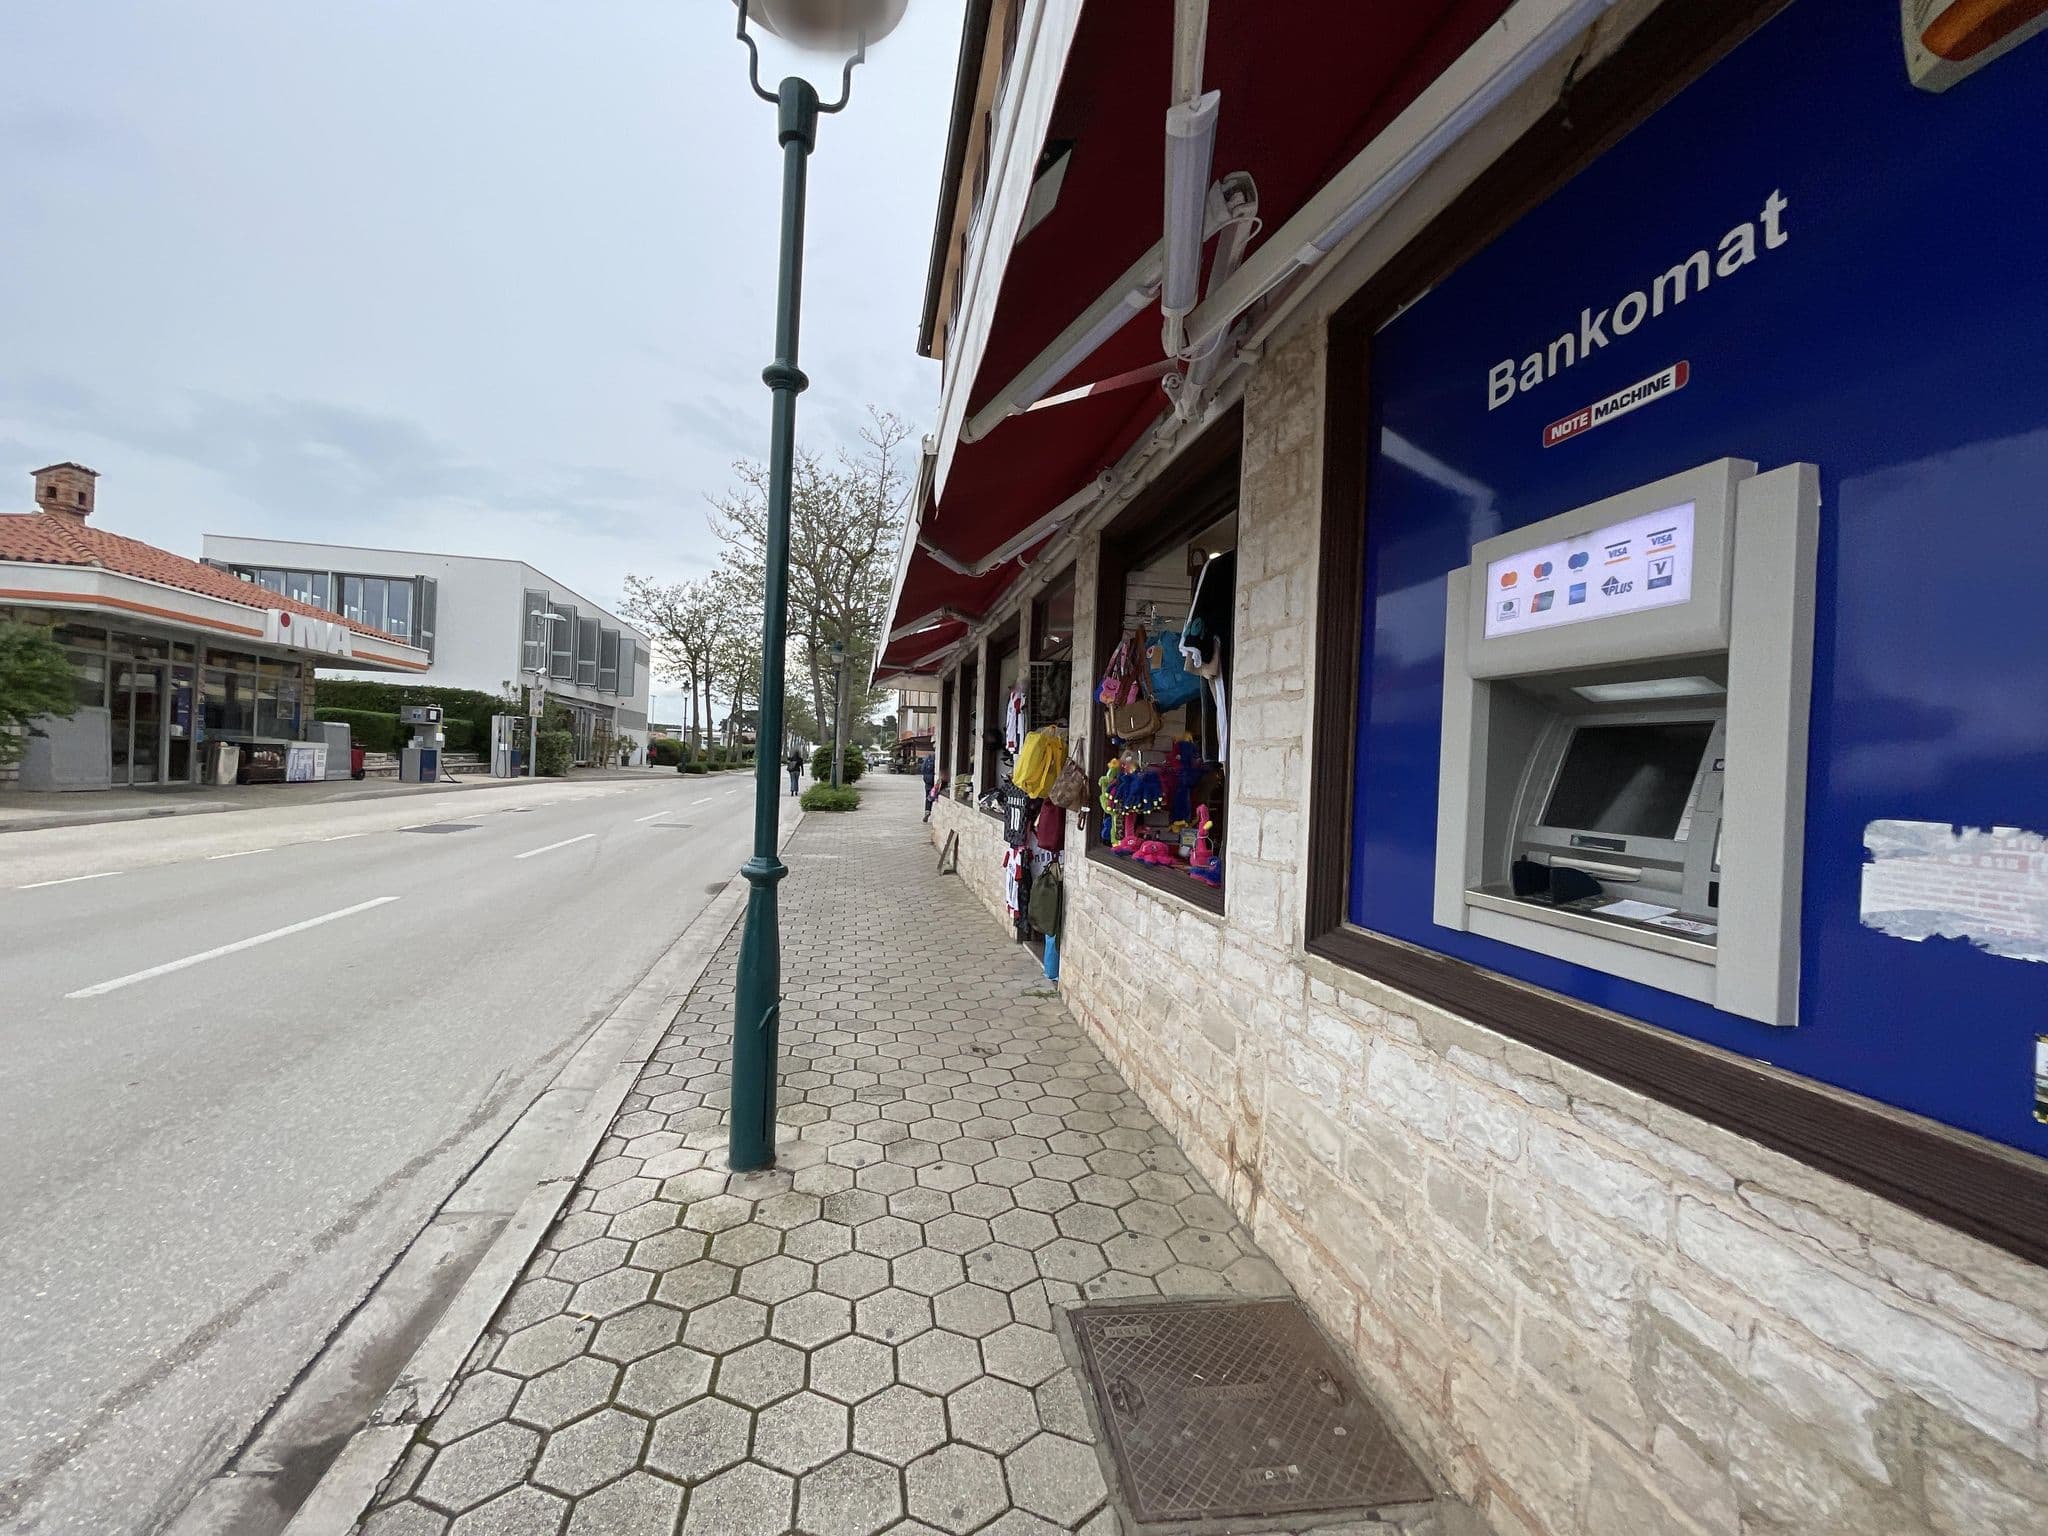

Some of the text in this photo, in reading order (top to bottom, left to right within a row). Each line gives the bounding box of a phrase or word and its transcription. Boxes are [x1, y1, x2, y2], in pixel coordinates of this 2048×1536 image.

[1488, 188, 1789, 411] Bankomat
[1551, 373, 1671, 440] NOTE MACHINE
[1651, 534, 1672, 545] VISA
[1608, 547, 1627, 558] VISA
[1608, 581, 1633, 596] PLUS
[1010, 807, 1020, 831] 10
